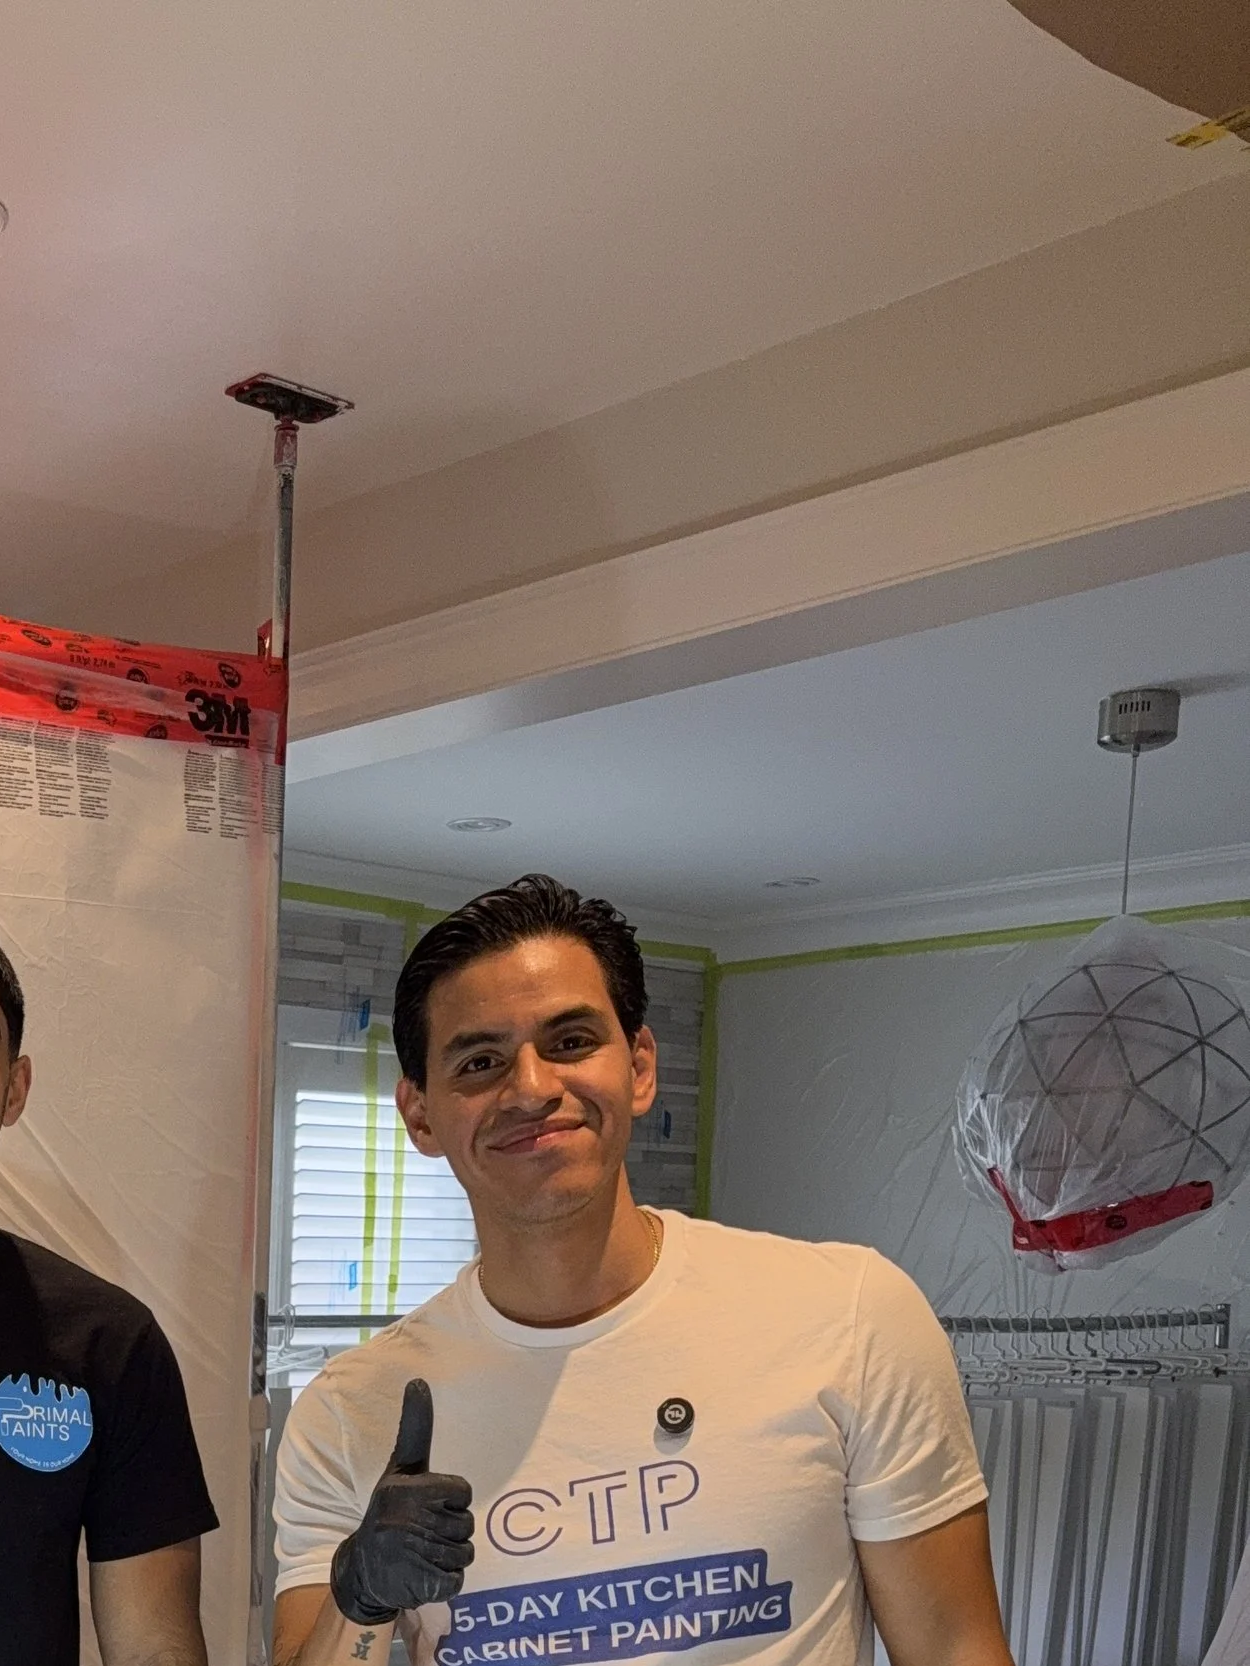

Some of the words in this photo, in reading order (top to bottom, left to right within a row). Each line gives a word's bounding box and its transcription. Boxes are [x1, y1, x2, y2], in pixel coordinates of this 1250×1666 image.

[185, 689, 250, 735] 3M
[486, 1460, 699, 1556] CTP
[454, 1592, 564, 1633] 5-DAY
[577, 1562, 761, 1612] KITCHEN
[610, 1595, 783, 1648] PAINTING
